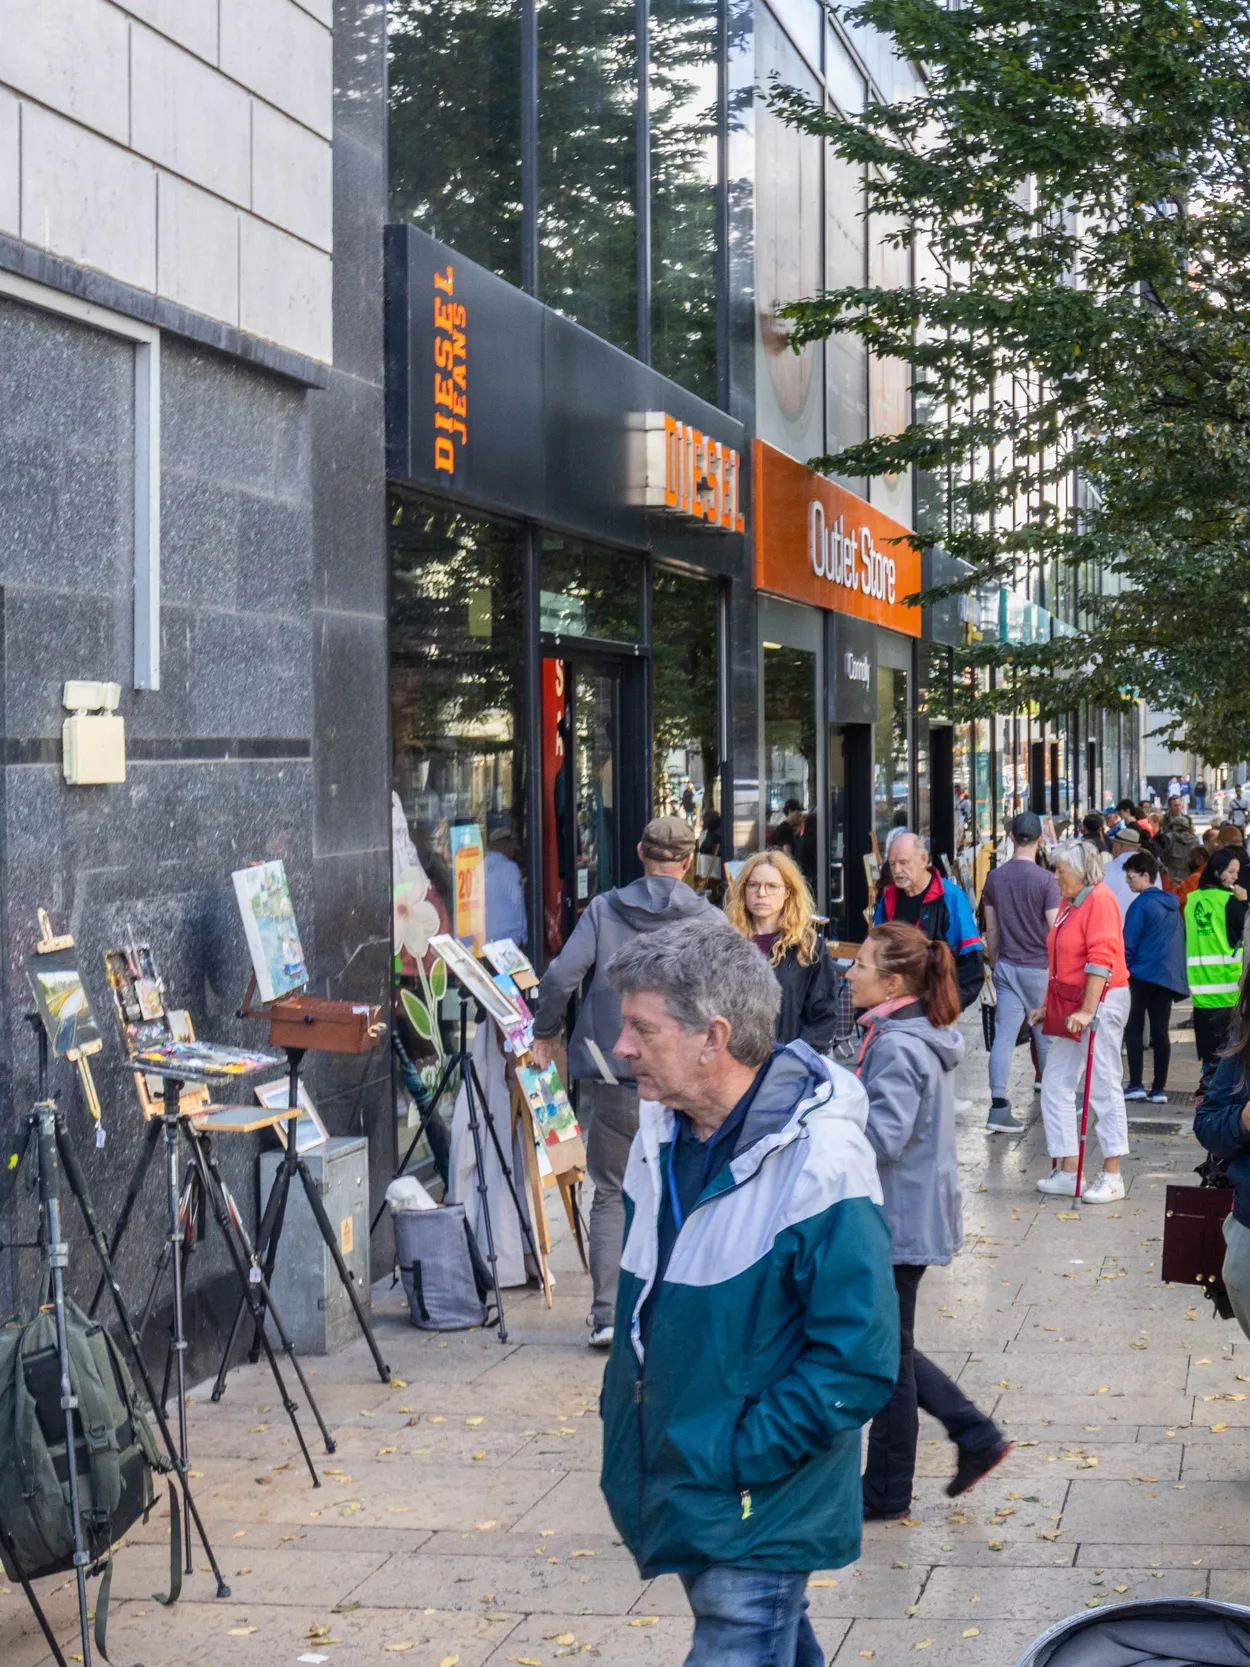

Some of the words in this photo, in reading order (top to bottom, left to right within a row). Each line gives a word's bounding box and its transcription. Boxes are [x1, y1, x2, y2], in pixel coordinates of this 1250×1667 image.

[434, 265, 454, 474] DIESEL
[450, 302, 467, 445] JEANS
[664, 412, 745, 533] DIESEL
[810, 500, 859, 591] Outlet
[859, 526, 896, 605] Store
